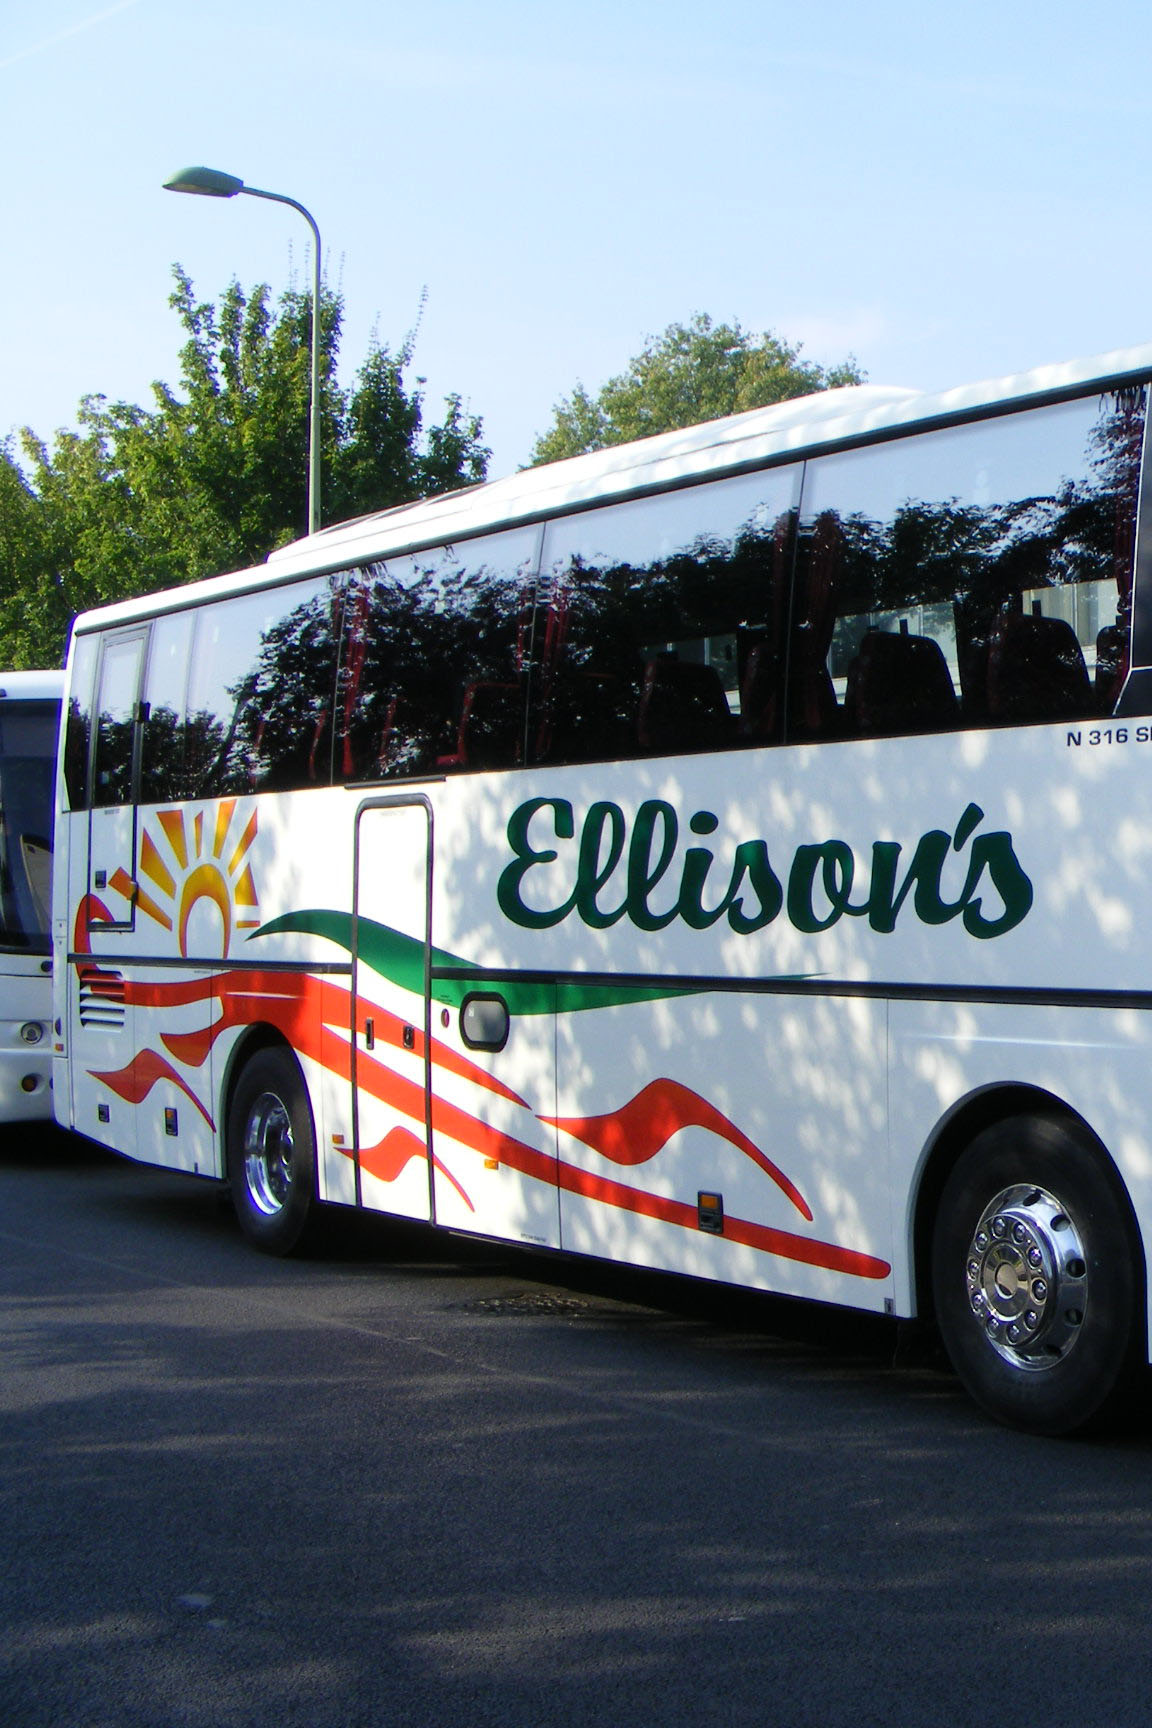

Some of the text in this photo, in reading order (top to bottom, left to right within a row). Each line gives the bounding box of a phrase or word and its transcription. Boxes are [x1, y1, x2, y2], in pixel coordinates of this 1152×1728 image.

[1066, 731, 1082, 747] N
[1088, 728, 1129, 746] 316
[497, 797, 1034, 940] Ellison's
